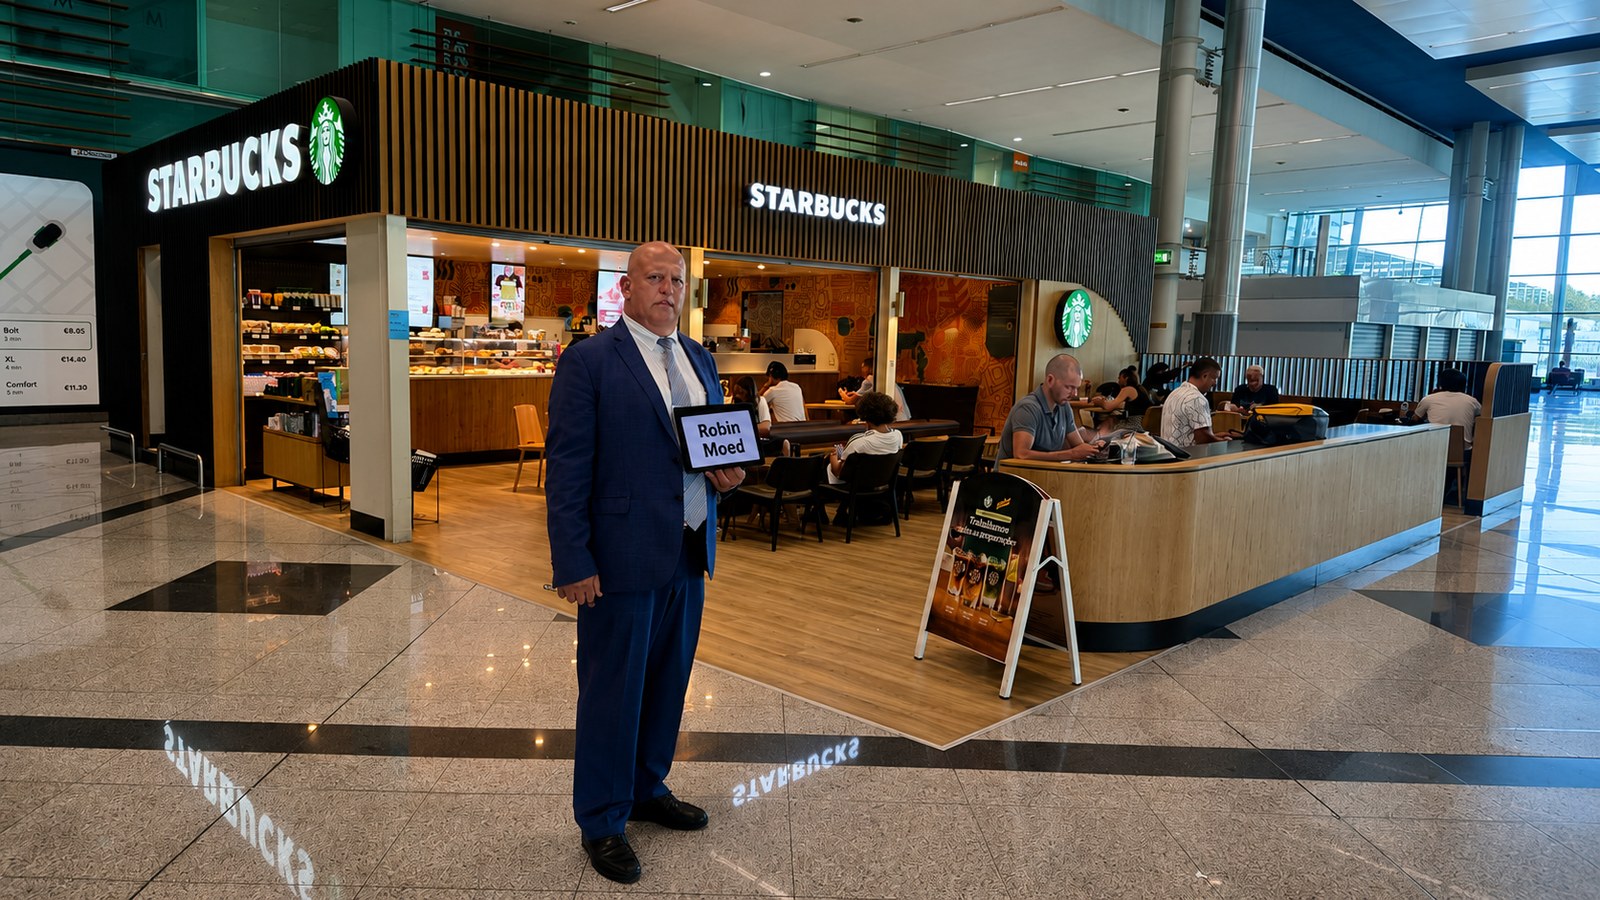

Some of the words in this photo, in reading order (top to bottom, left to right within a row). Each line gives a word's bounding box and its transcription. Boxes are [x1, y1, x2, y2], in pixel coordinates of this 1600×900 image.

[147, 123, 301, 213] STARBUCKS
[749, 182, 886, 226] STARBUCKS
[697, 420, 741, 438] Robin
[702, 438, 746, 458] Moed
